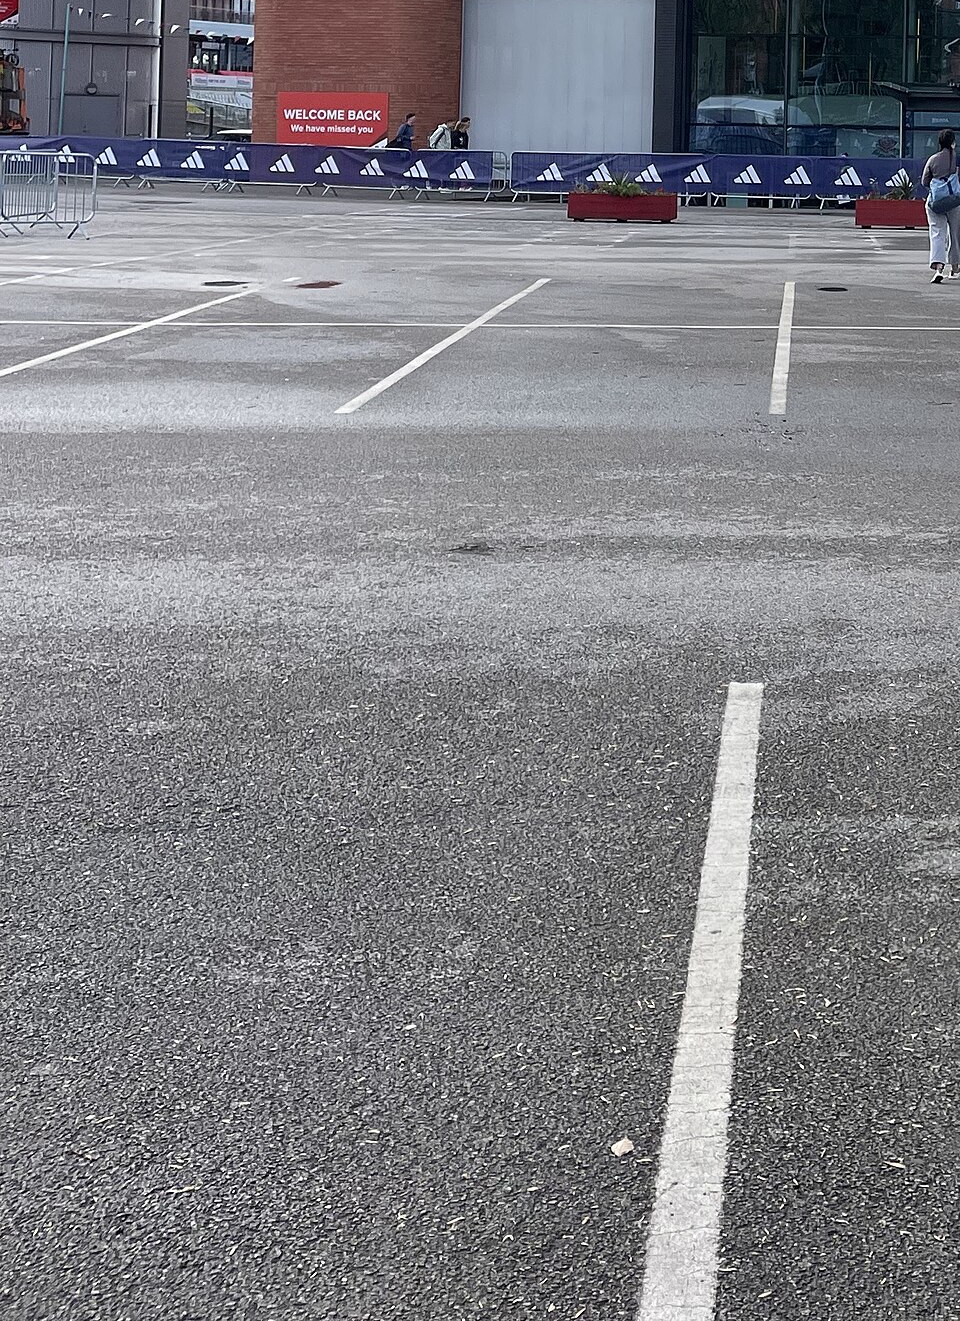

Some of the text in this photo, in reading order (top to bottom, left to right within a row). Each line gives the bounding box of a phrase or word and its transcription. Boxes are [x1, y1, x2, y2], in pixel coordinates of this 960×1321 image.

[283, 109, 381, 121] WELCOME BACK
[290, 124, 373, 135] We have missed you
